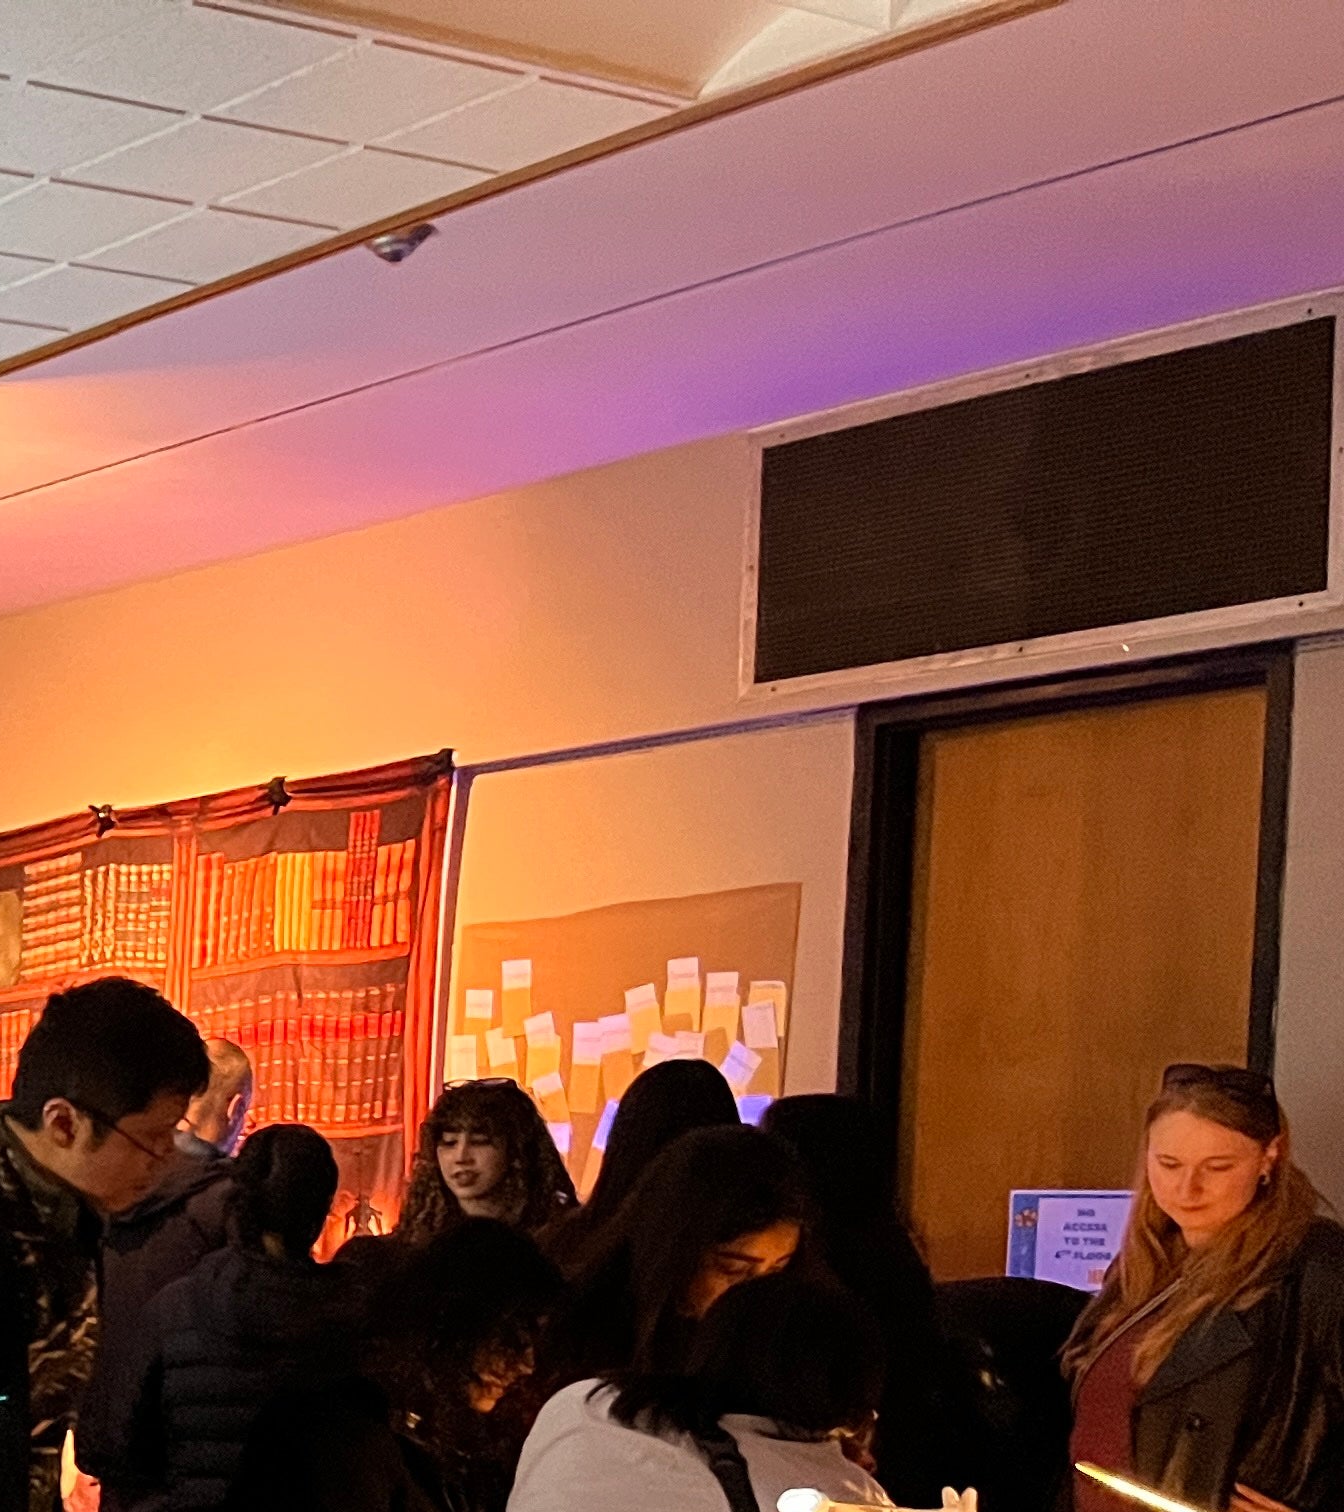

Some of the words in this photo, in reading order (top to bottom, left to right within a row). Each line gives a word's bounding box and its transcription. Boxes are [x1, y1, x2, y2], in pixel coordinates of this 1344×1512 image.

[1062, 1222, 1108, 1232] ACCESS
[1064, 1236, 1080, 1246] TO
[1082, 1236, 1105, 1247] THE
